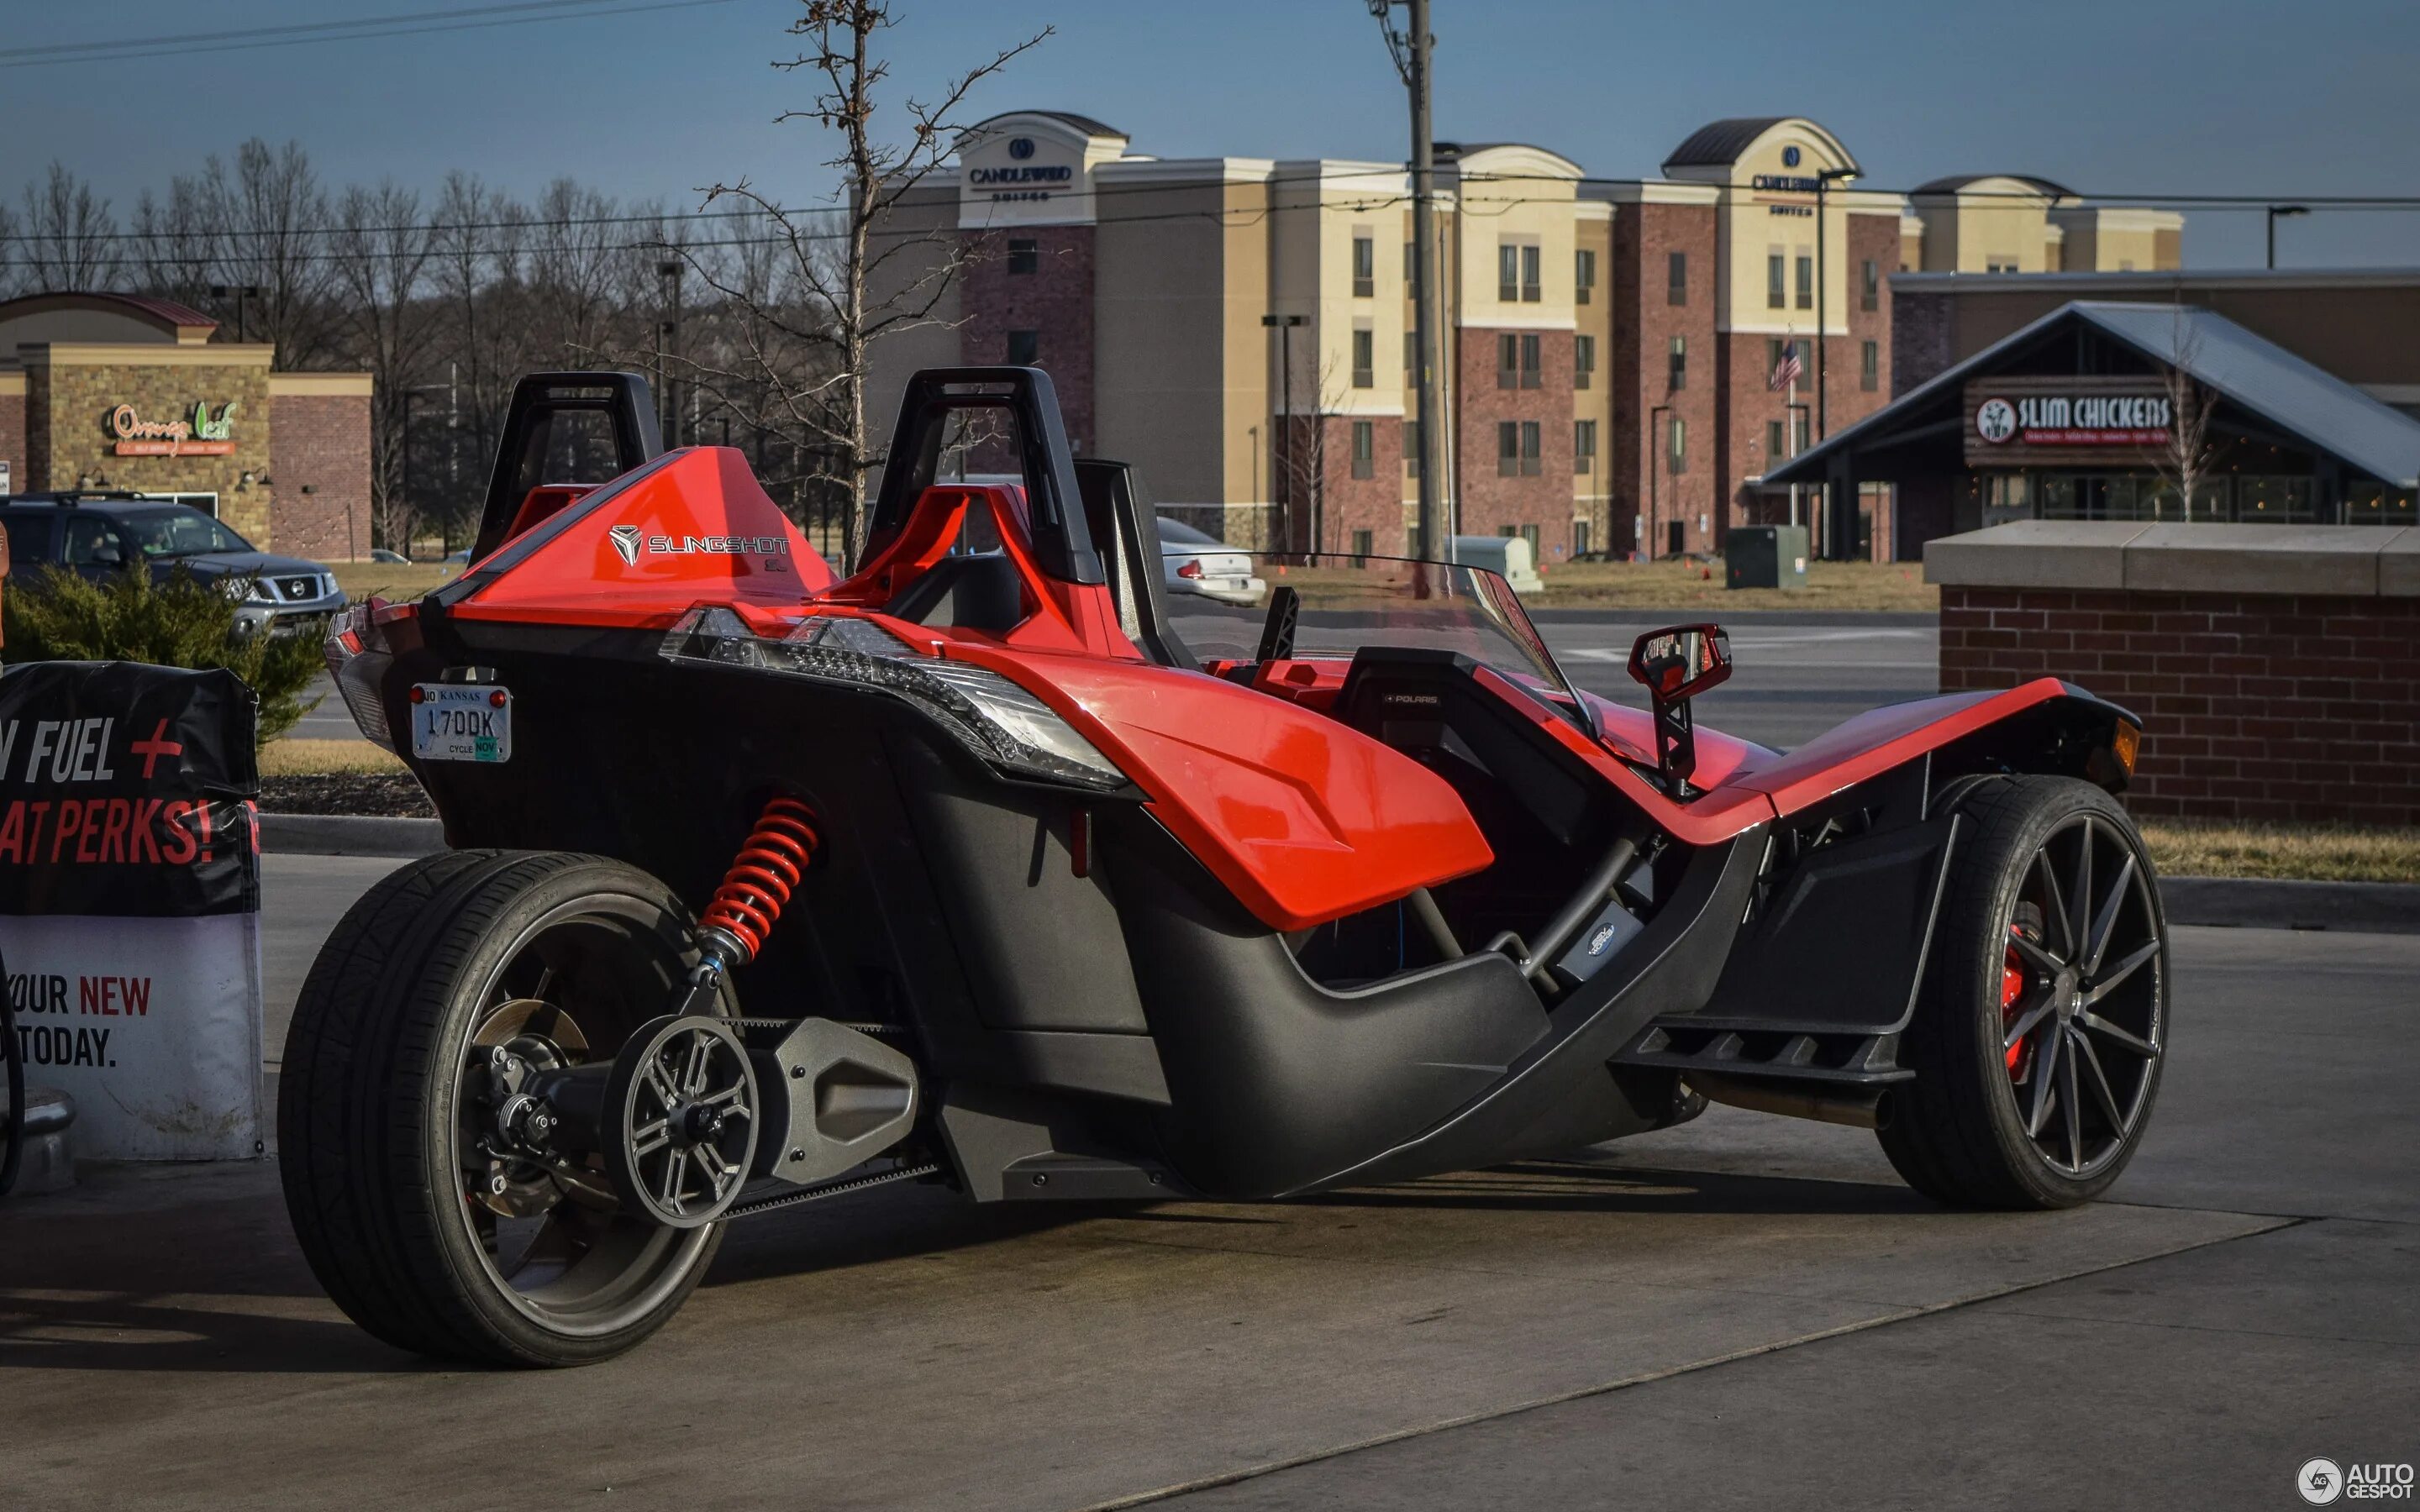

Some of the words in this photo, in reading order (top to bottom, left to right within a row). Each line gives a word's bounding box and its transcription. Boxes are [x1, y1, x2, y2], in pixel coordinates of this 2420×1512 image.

[2018, 397, 2070, 428] SLIM
[2074, 397, 2170, 428] CHICKENS
[113, 404, 188, 458] Orange
[649, 536, 790, 554] SLINGSHOT
[441, 691, 481, 701] KANSAS
[25, 717, 114, 783] FUEL
[450, 745, 474, 753] CYCLE
[476, 743, 494, 752] NOV
[50, 798, 212, 864] PERKS!
[80, 976, 151, 1016] NEW
[17, 1025, 116, 1067] TODAY.
